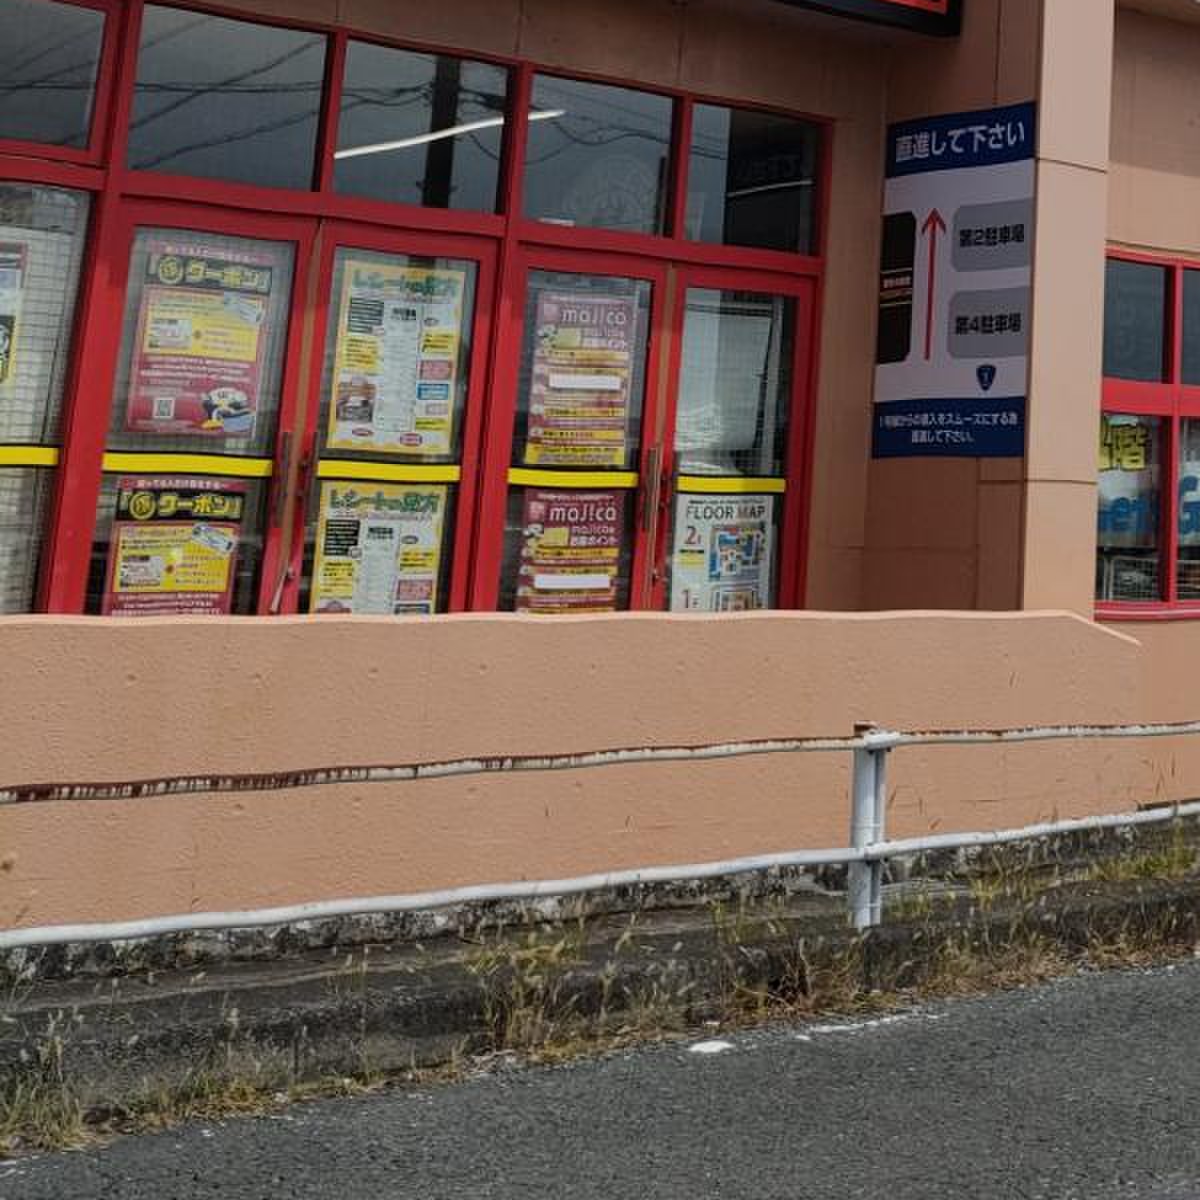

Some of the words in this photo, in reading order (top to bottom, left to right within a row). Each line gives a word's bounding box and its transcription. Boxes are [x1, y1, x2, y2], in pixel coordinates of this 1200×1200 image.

[896, 121, 1025, 162] 直進して下さい
[687, 506, 734, 520] FLOOR
[737, 505, 766, 519] MAP
